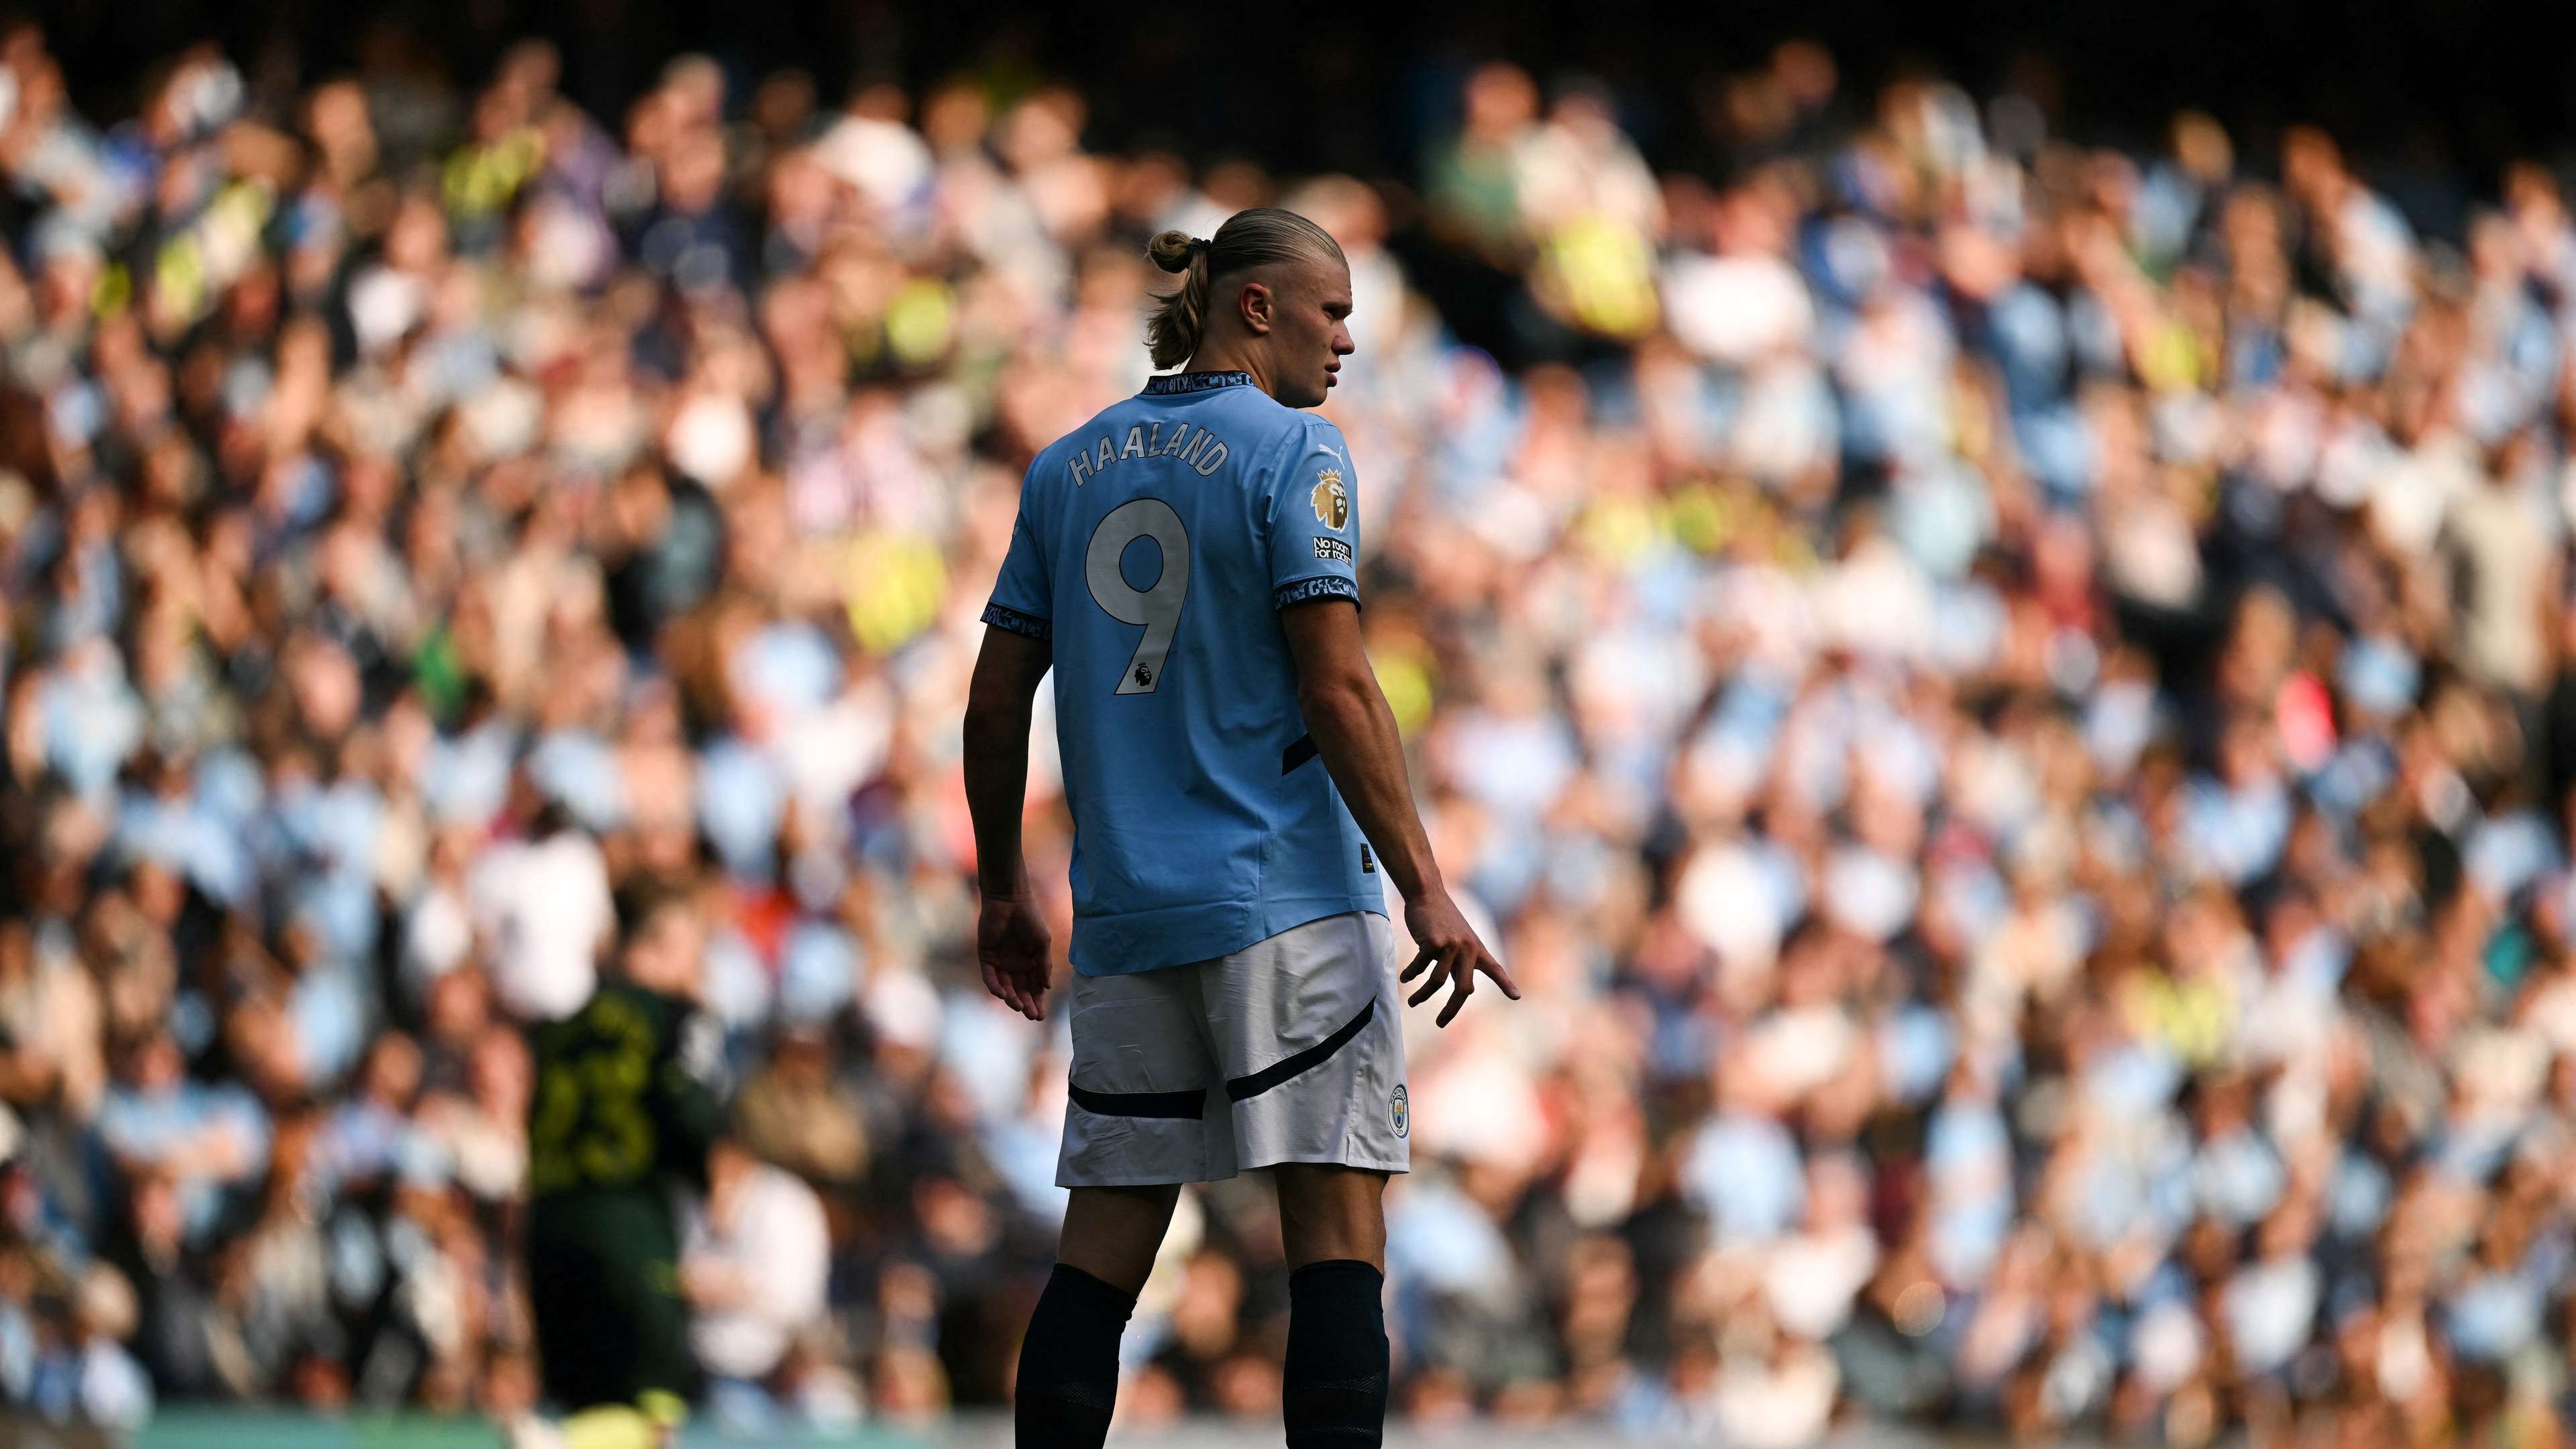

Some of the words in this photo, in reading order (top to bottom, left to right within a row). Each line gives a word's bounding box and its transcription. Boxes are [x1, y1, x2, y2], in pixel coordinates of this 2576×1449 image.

[1068, 422, 1228, 488] HAALAND
[1313, 537, 1331, 549] No
[1332, 541, 1350, 556] room
[1085, 498, 1190, 695] 9
